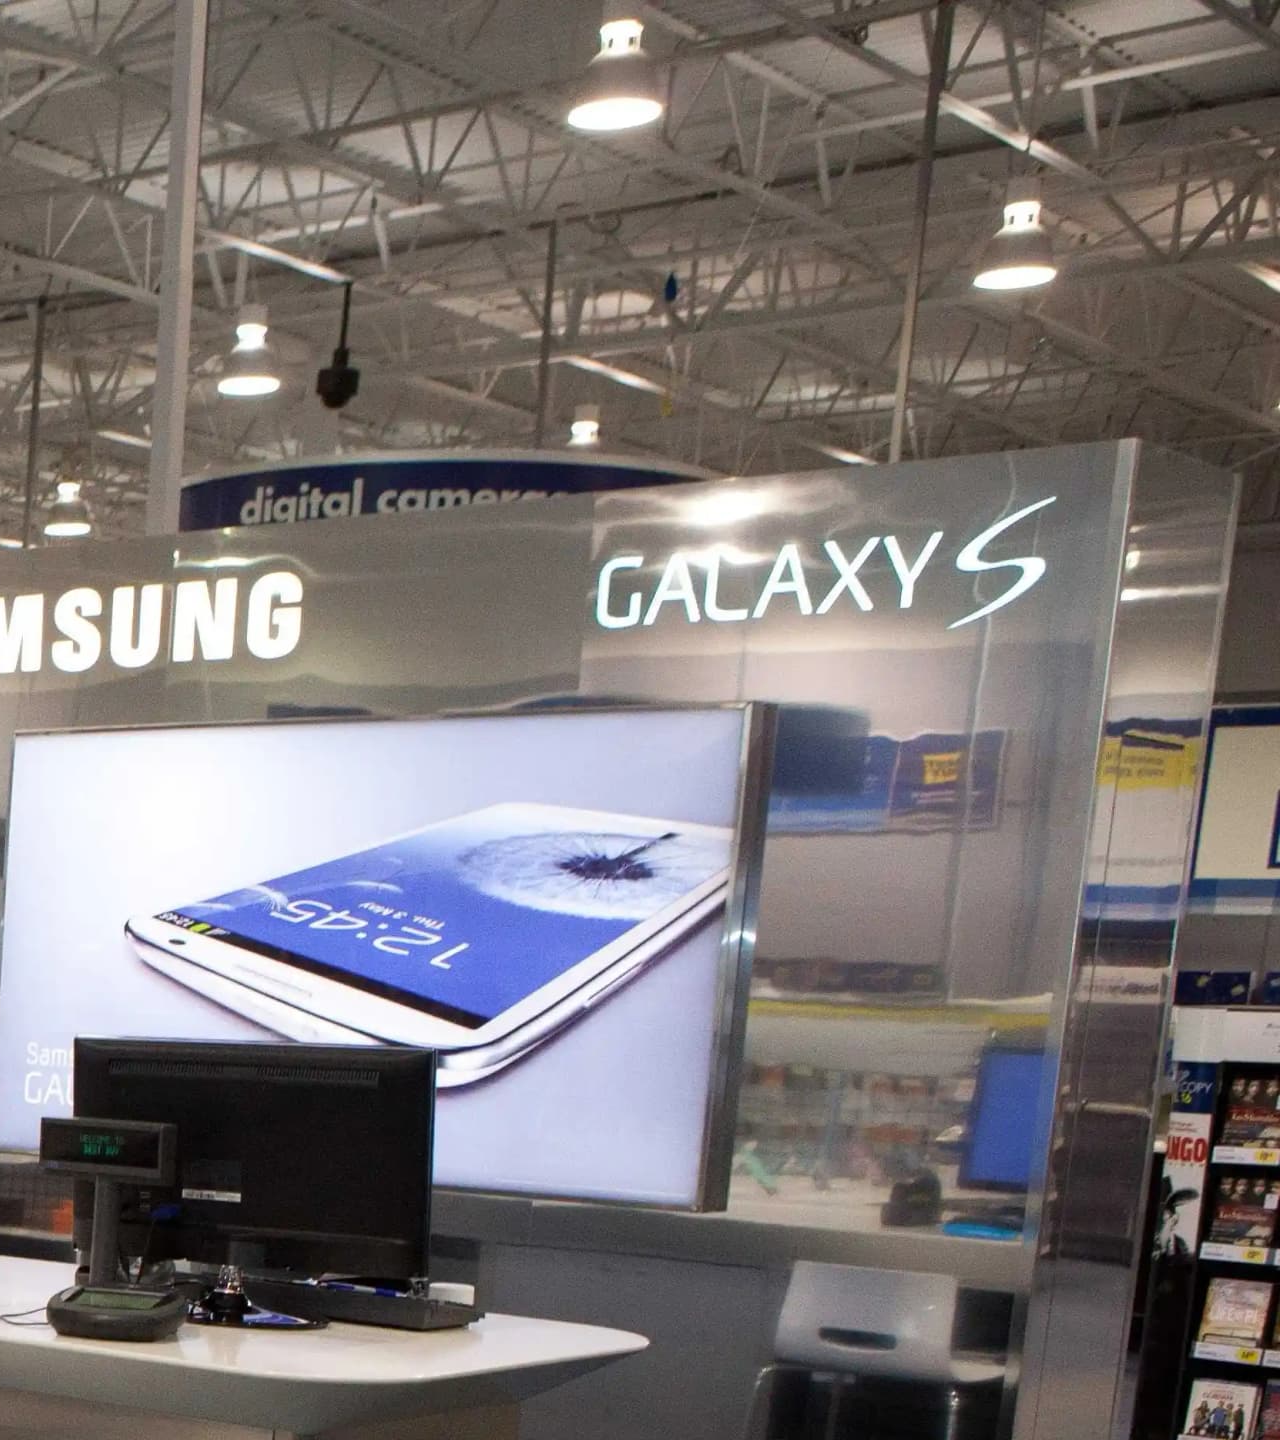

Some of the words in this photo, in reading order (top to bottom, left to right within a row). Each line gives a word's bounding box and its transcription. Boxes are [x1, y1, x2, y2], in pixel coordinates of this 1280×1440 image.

[239, 478, 364, 525] digital
[376, 486, 568, 515] came
[595, 531, 944, 629] GALAXY
[946, 496, 1057, 629] S
[269, 898, 470, 970] 12:45
